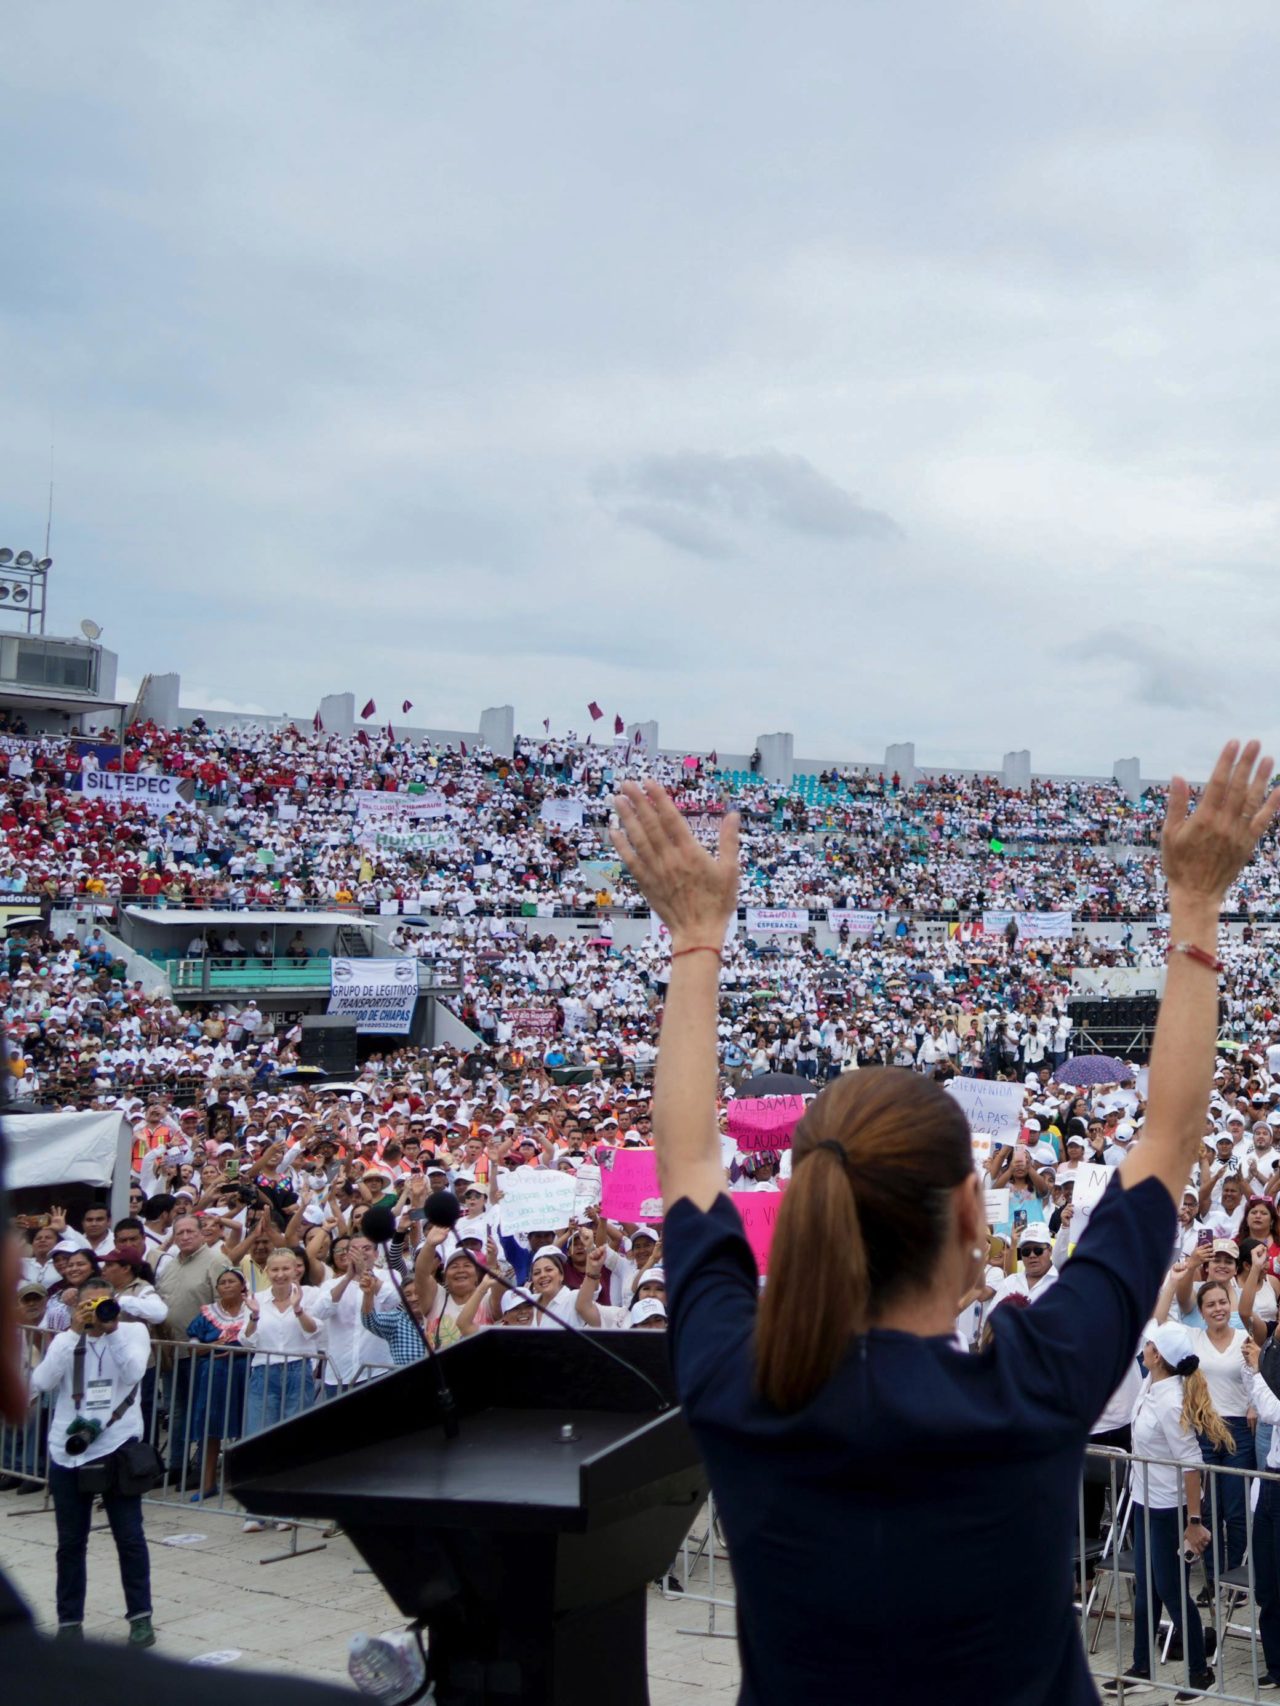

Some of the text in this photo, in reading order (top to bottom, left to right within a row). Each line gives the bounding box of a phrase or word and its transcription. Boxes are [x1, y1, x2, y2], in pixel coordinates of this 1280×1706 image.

[332, 985, 417, 997] GRUPO DE LEGITIMOS
[338, 998, 407, 1008] TRANSPORTISTAS
[368, 1010, 379, 1021] DE
[380, 1009, 410, 1021] CHIAPAS
[951, 1080, 1013, 1097] BIENVENIDA
[735, 1097, 799, 1112] ALDAMA
[975, 1096, 983, 1107] A
[737, 1133, 792, 1149] CLAUDIA
